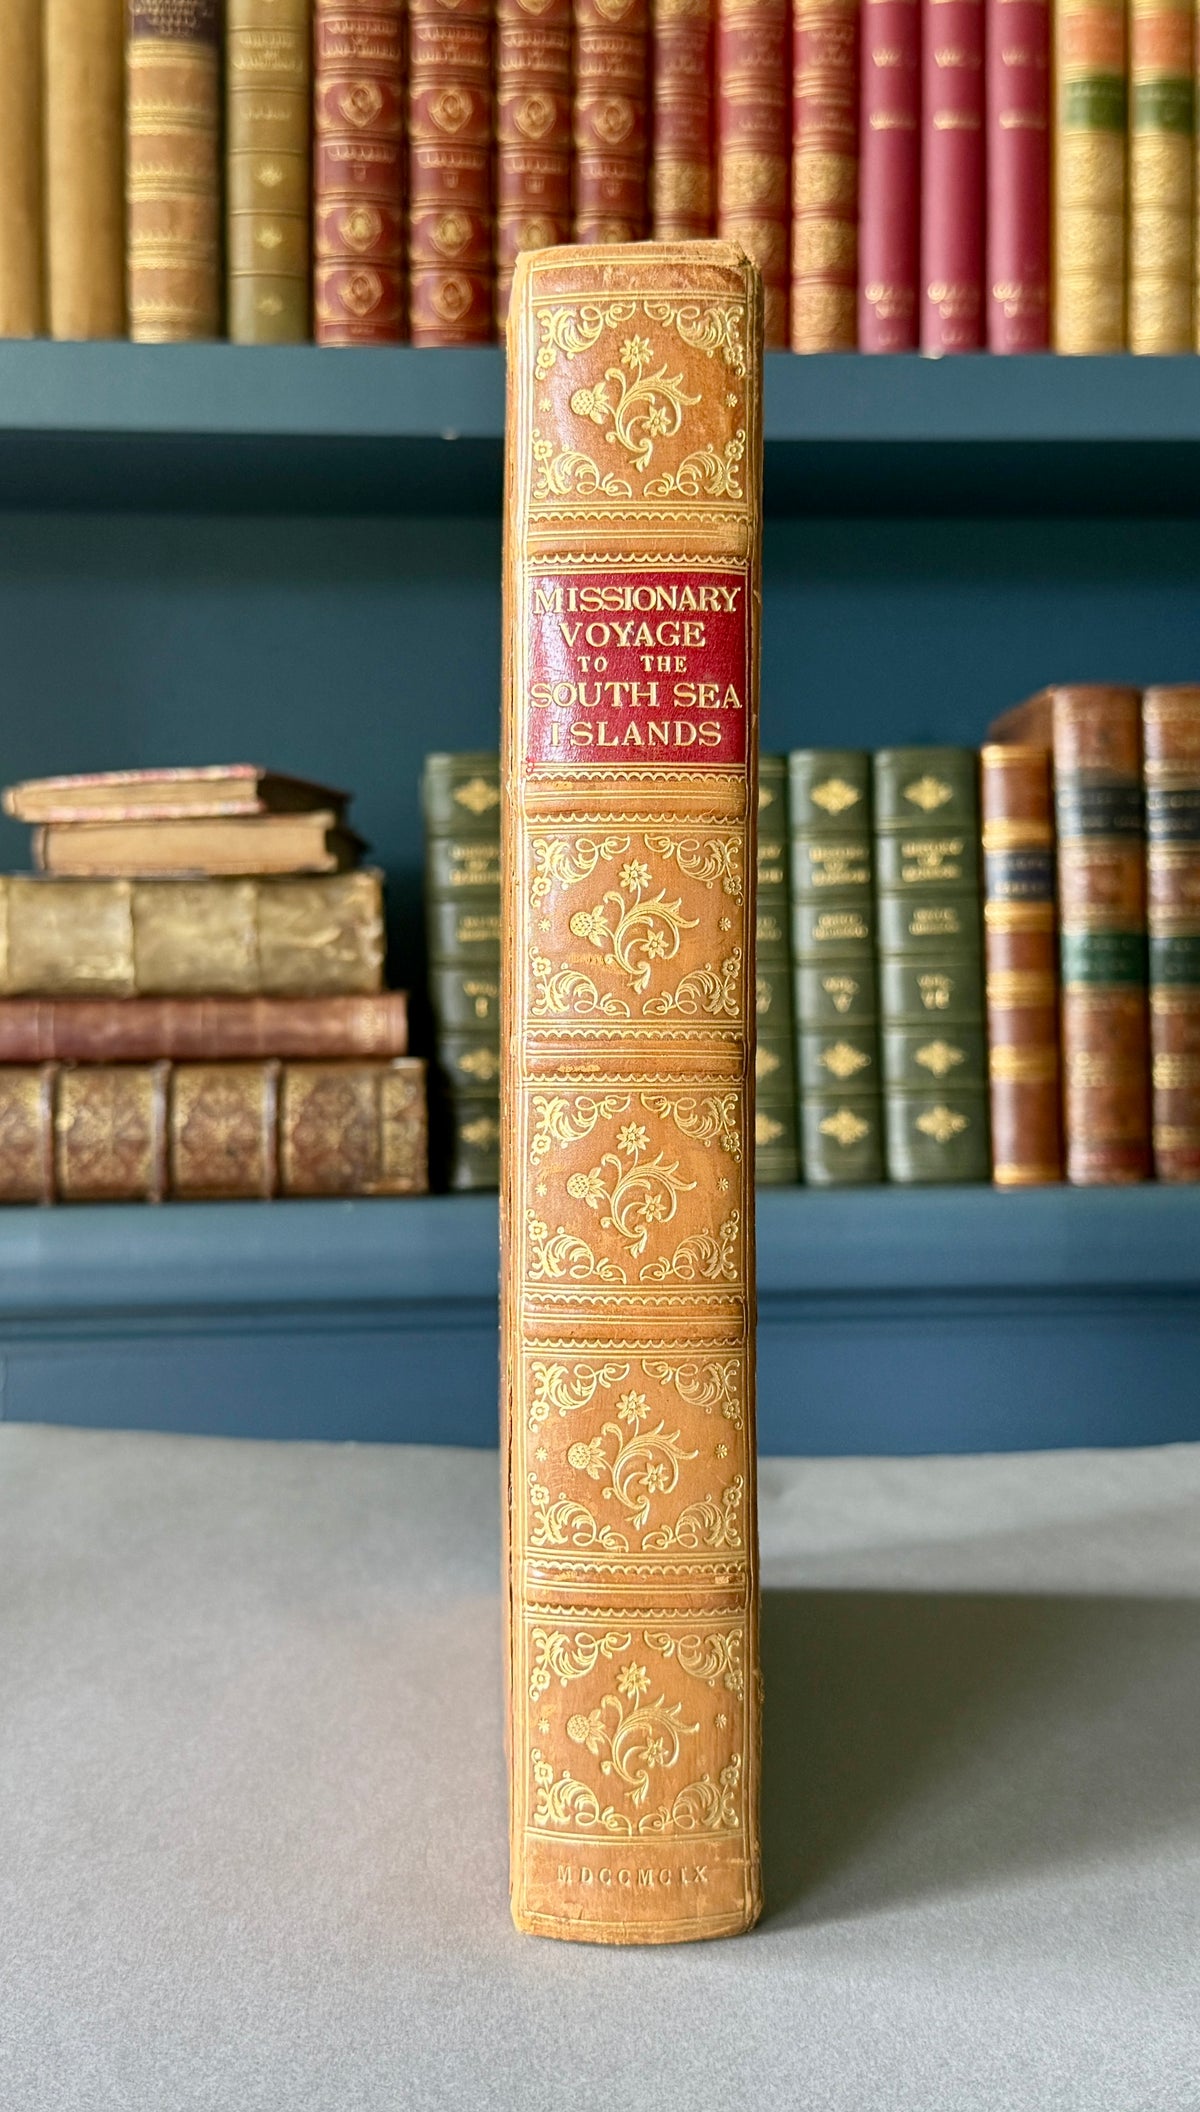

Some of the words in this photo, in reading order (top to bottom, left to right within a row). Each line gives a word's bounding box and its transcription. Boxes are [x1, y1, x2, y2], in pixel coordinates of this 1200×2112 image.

[533, 585, 742, 614] MISSIONARY
[559, 620, 706, 648] VOYAGE
[577, 655, 608, 672] TO
[640, 655, 687, 673] THE
[530, 681, 660, 708] SOUTH
[673, 682, 743, 709] SEA
[550, 721, 722, 747] ISLANDS
